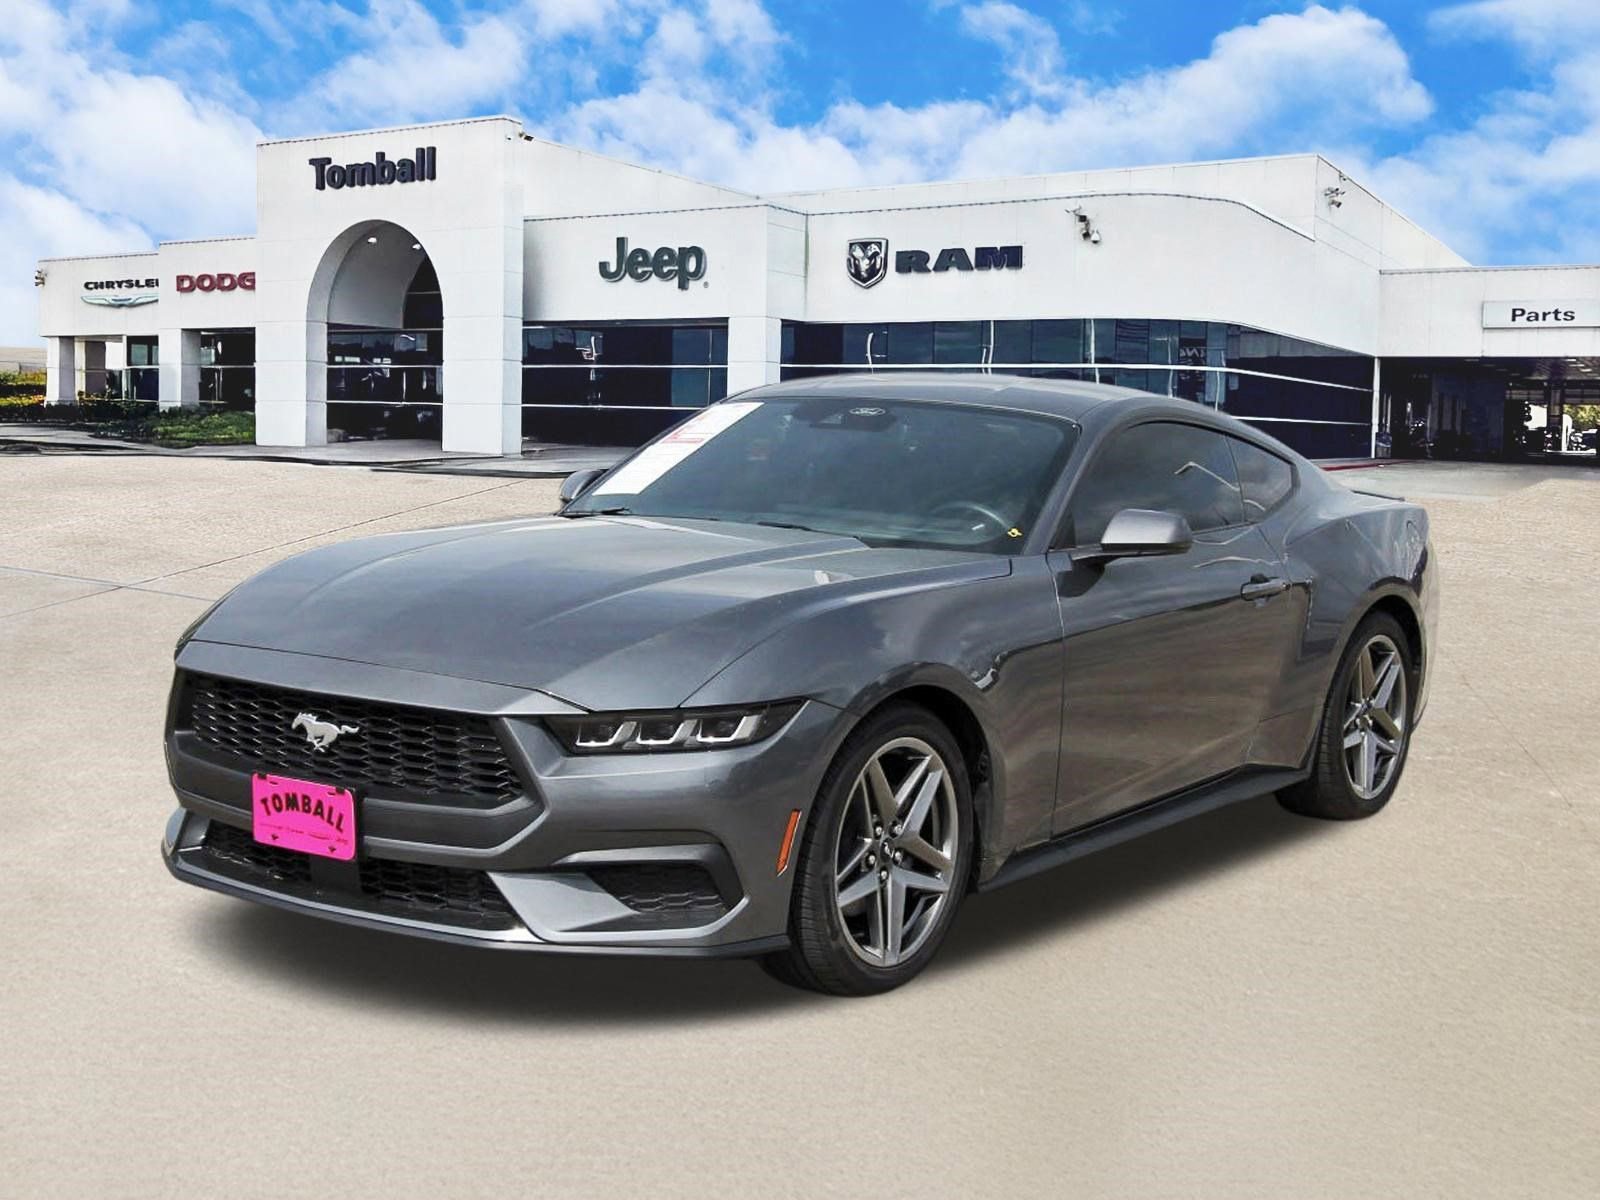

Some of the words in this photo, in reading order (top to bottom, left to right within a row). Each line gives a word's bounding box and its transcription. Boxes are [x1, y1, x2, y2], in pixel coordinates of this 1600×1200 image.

[308, 146, 437, 190] Tomball
[599, 236, 707, 291] Jeep
[895, 245, 1023, 273] RAM
[84, 278, 159, 290] CHRYSLE
[1511, 307, 1576, 322] Parts
[260, 792, 345, 833] TOMBALL
